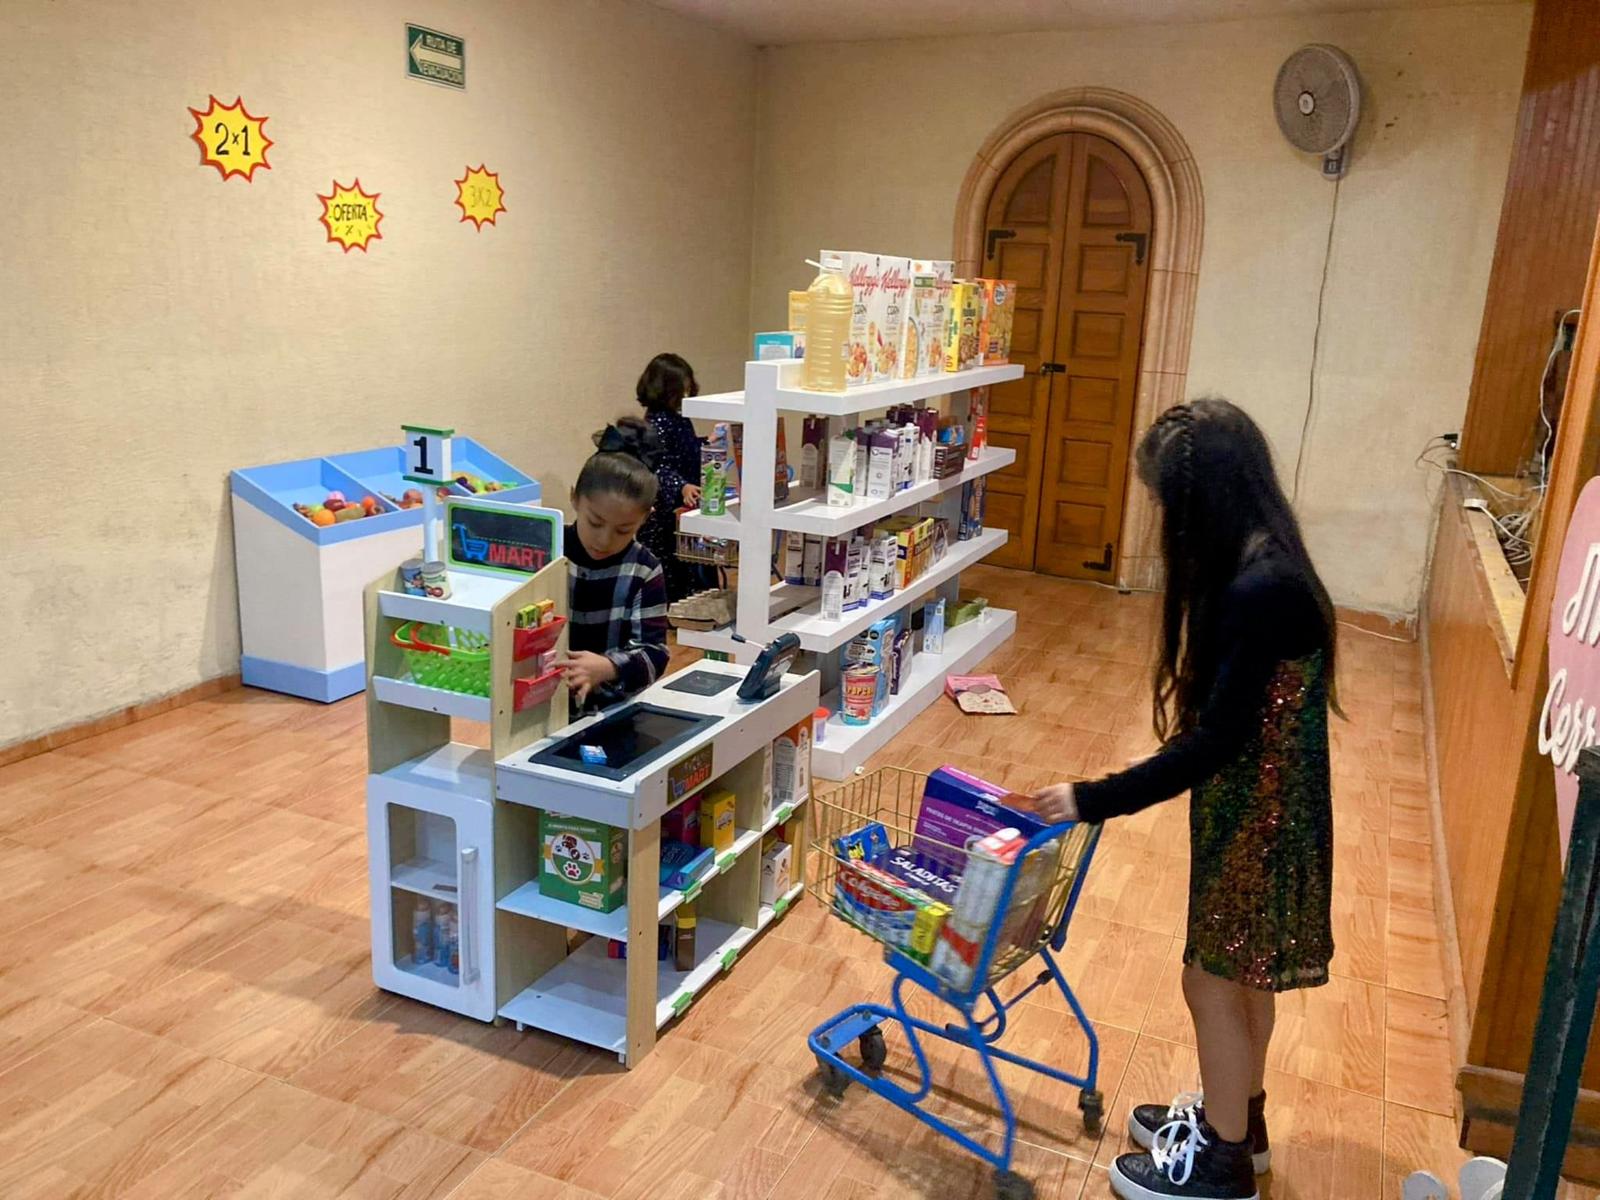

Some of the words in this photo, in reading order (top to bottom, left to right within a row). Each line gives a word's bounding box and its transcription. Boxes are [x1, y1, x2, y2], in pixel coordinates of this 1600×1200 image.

[425, 34, 446, 50] RUTA
[446, 40, 457, 54] DE
[214, 122, 251, 156] 2x1
[333, 204, 368, 222] OFERTA
[413, 436, 434, 475] 1
[488, 544, 547, 570] MART
[840, 871, 900, 908] Colgate
[889, 856, 958, 893] SALADITAS
